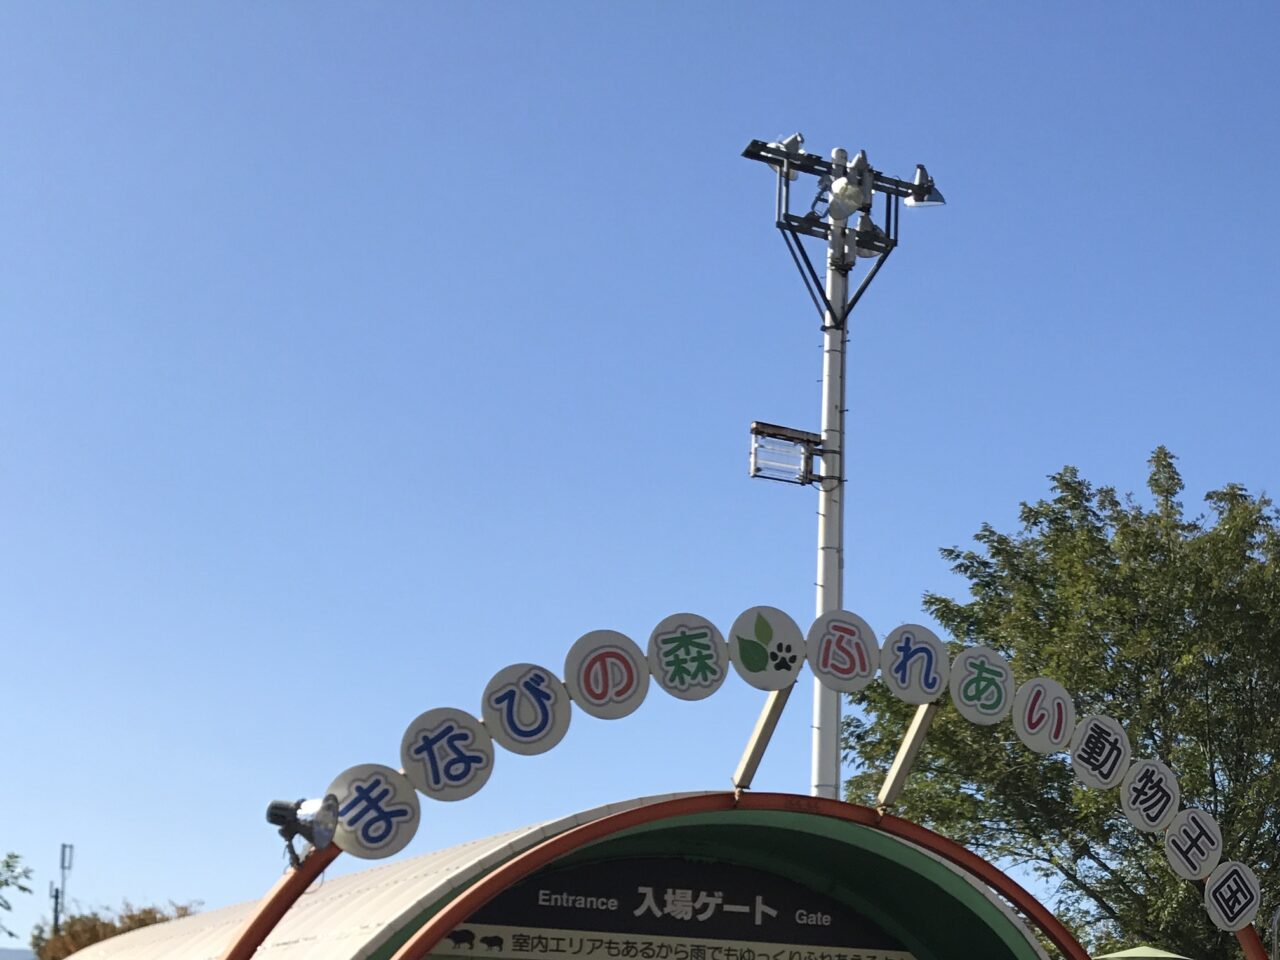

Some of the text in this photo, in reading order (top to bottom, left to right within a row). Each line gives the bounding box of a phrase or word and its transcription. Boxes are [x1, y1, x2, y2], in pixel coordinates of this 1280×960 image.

[340, 624, 1255, 922] まなびの森 ふれあい動物王国
[538, 890, 619, 911] Entrance
[633, 886, 778, 926] 入場ゲート
[794, 910, 832, 926] Gate
